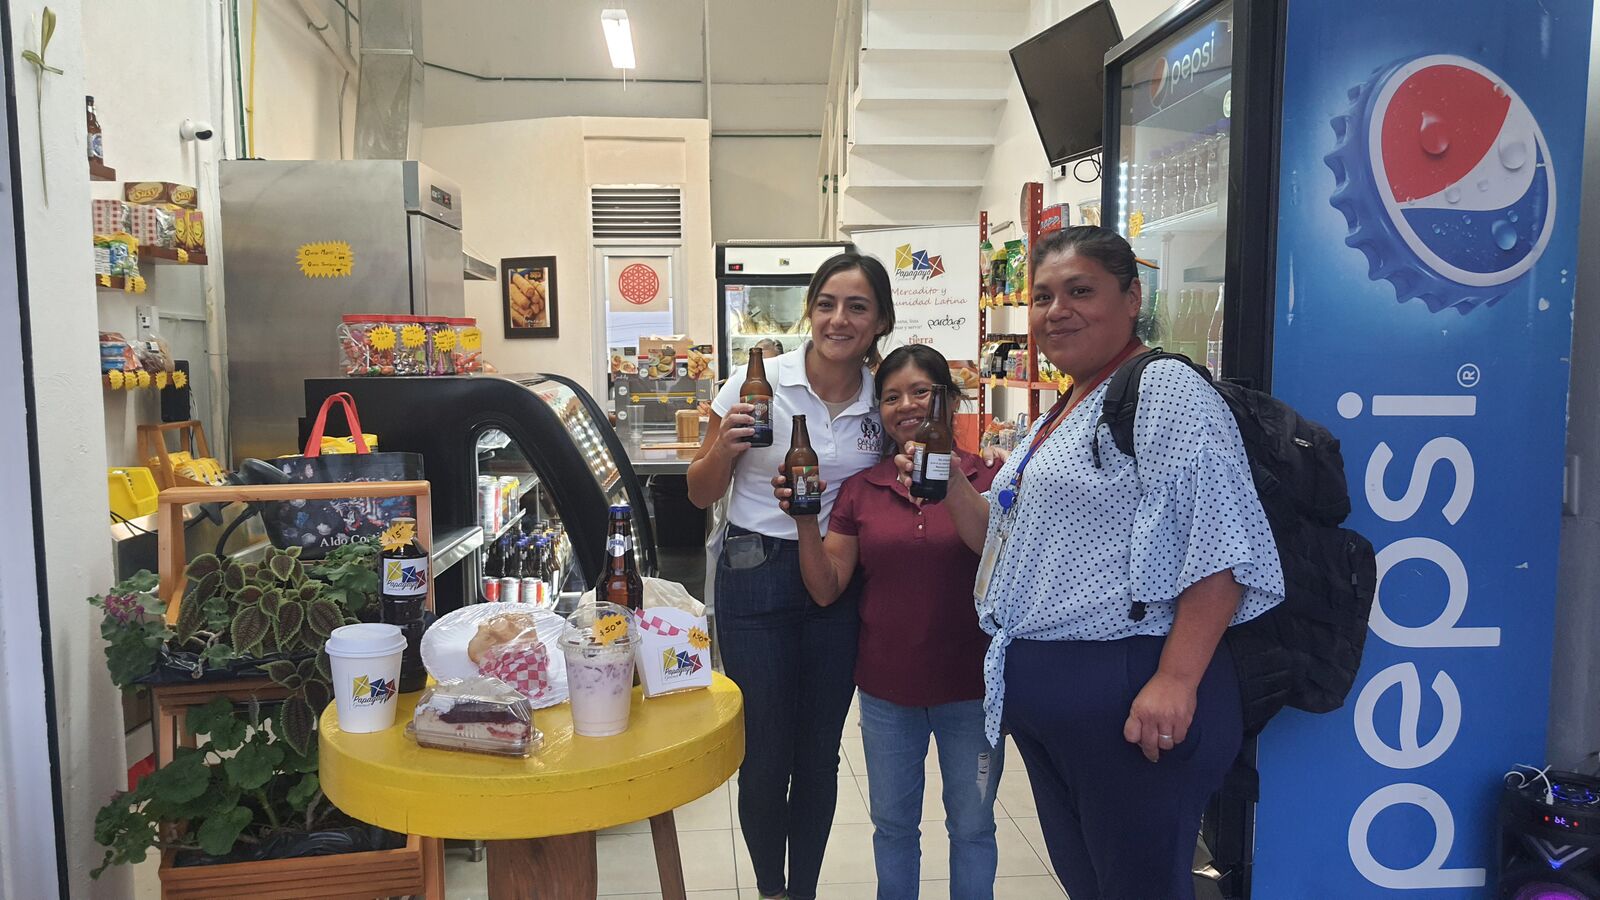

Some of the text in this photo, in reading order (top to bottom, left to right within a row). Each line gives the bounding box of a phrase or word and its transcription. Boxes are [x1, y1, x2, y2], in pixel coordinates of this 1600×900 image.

[1170, 30, 1215, 94] pepsi
[896, 269, 931, 280] Papagayo
[891, 287, 947, 296] Mercadito y
[893, 297, 967, 306] unidad Latina
[908, 335, 934, 345] tierra
[320, 536, 348, 547] Aldo
[1337, 392, 1501, 889] pepsi
